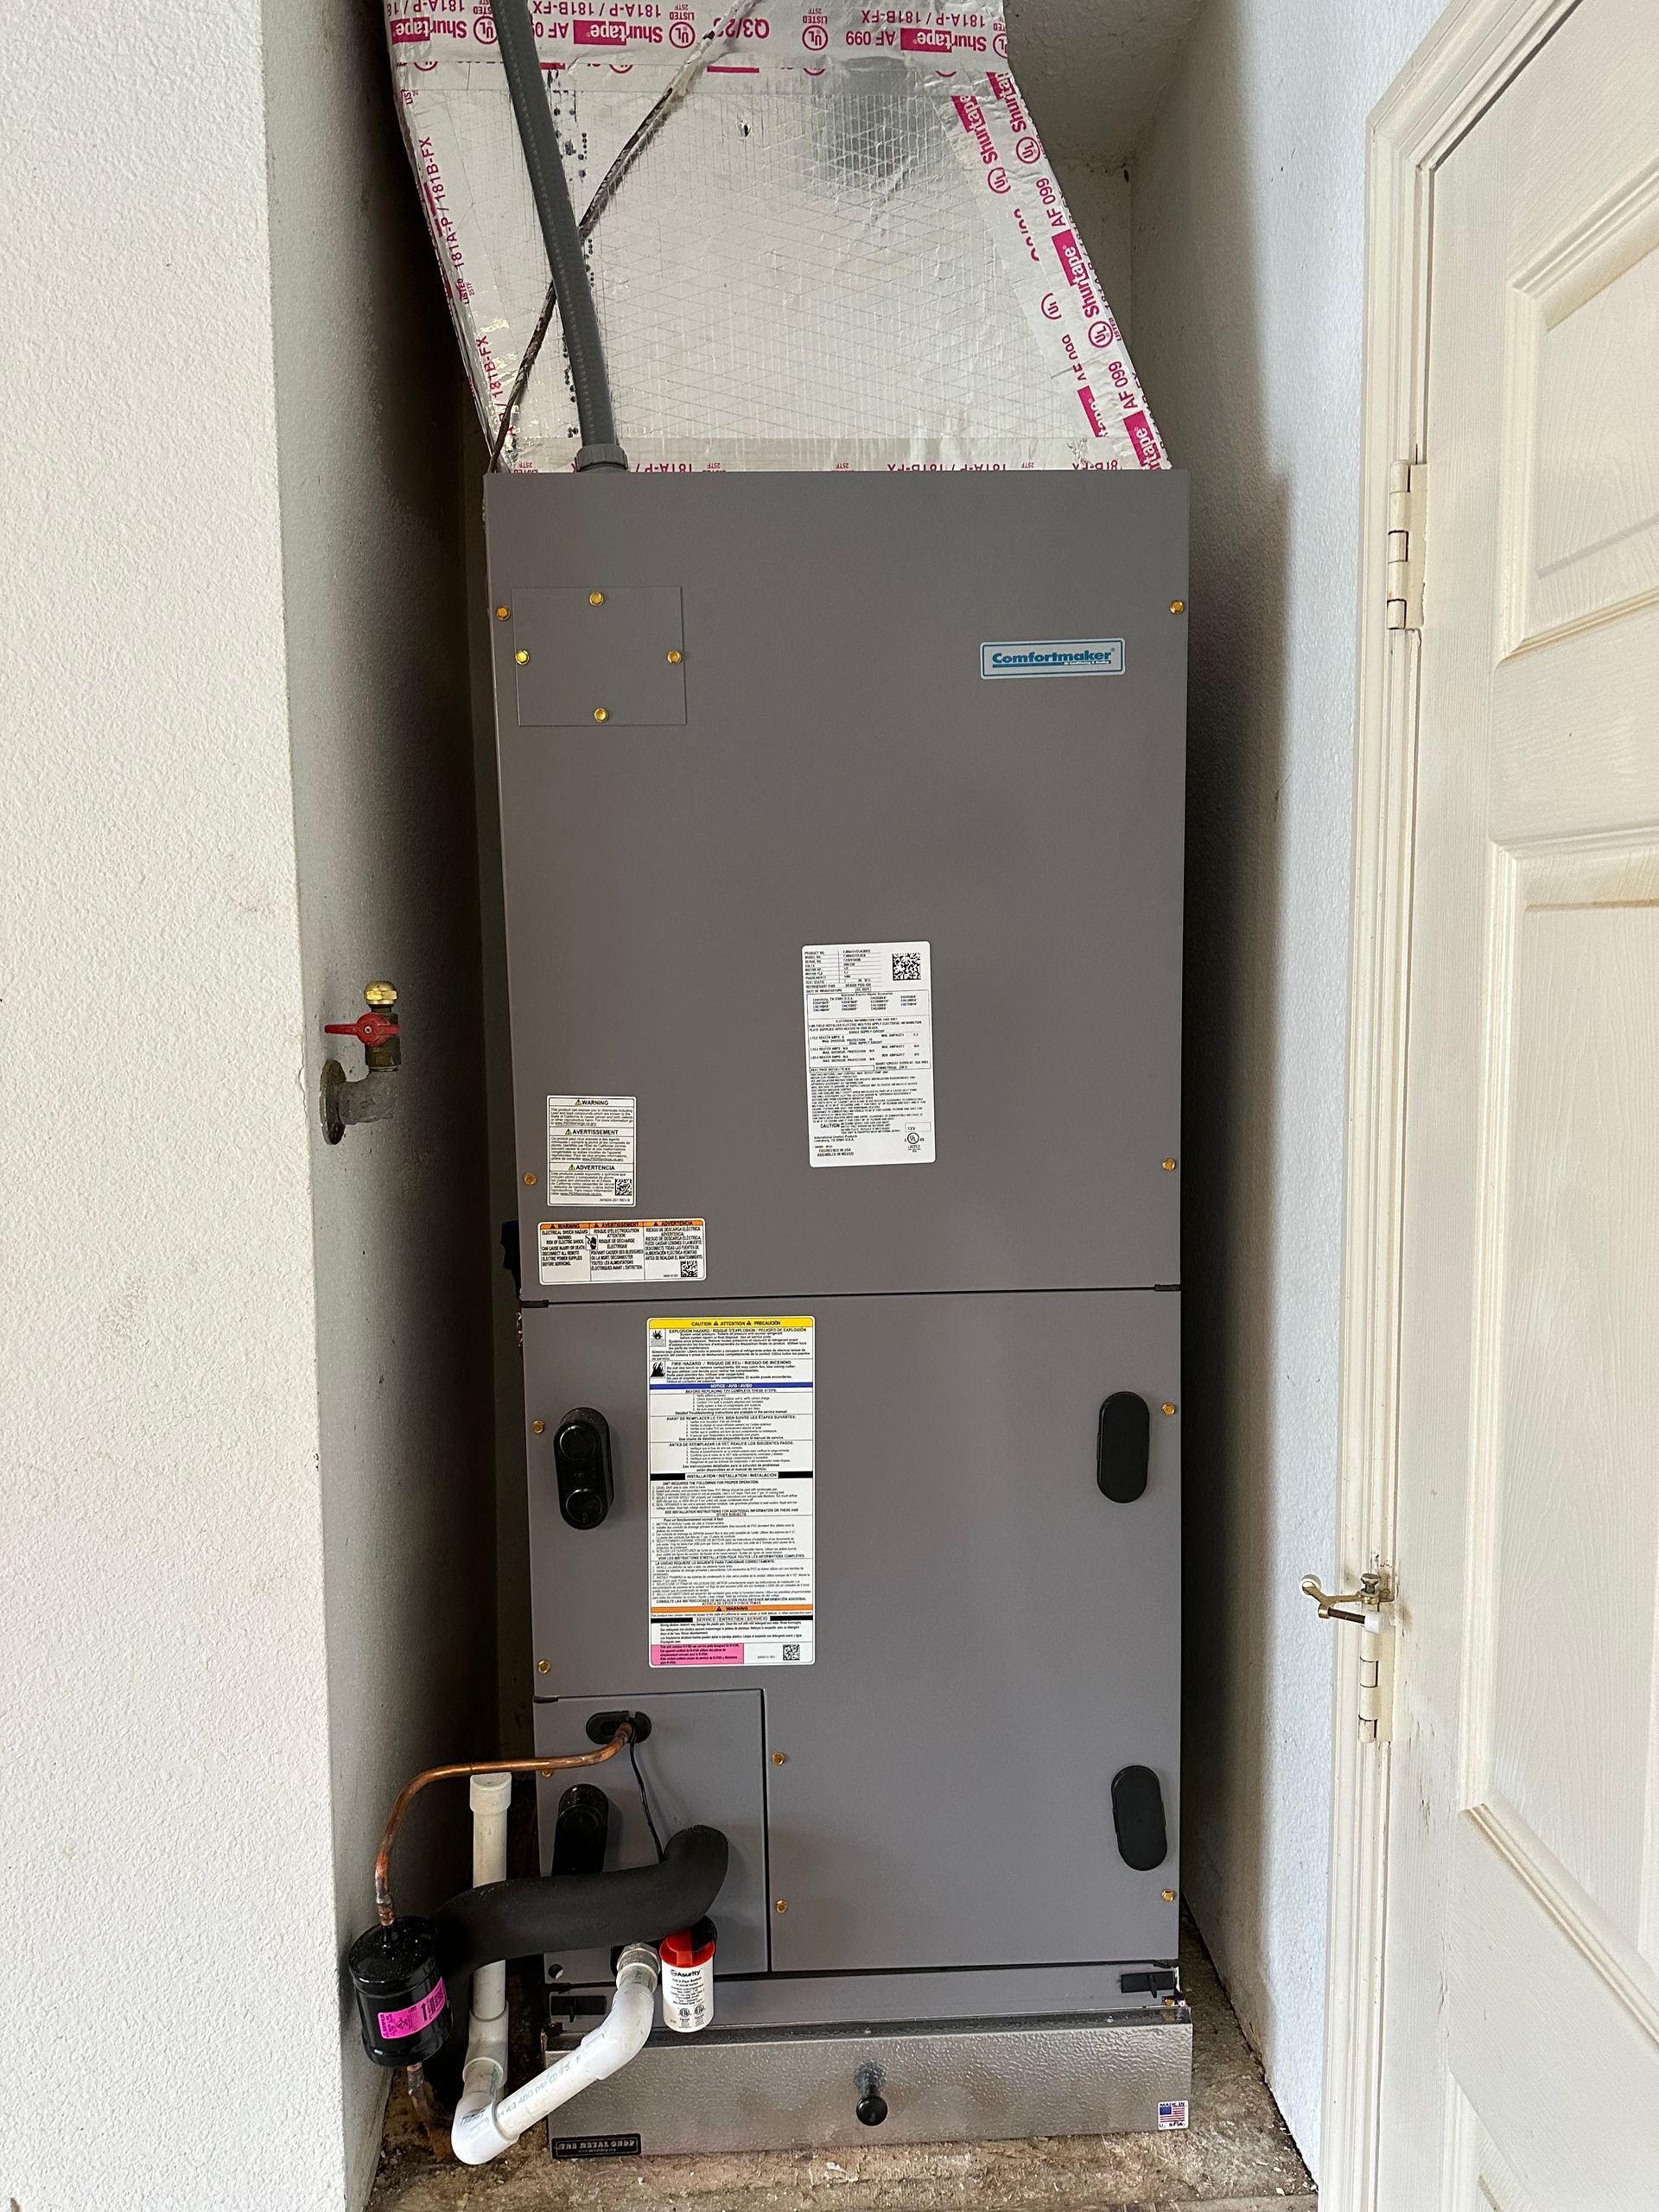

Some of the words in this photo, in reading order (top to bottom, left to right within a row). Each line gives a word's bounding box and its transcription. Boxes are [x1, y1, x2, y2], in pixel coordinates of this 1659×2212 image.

[533, 1, 595, 16] 181B-FX
[609, 3, 661, 17] 181A-P
[670, 11, 695, 21] LISTED
[861, 10, 921, 24] 181B-FX
[803, 16, 828, 24] LISTED
[936, 13, 986, 29] 181A-P
[395, 20, 467, 38] Shurtape
[549, 22, 569, 39] AF
[590, 22, 663, 43] Shurtape
[674, 28, 690, 42] UL
[808, 31, 822, 47] UL
[846, 31, 872, 46] 099
[875, 31, 896, 46] AF
[918, 32, 987, 52] Shurtape
[1021, 141, 1036, 159] UL
[419, 137, 446, 202] 181B-FX
[1036, 177, 1056, 205] 099
[1046, 207, 1066, 227] AF
[1065, 245, 1100, 319] Shurtape
[1094, 325, 1107, 344] UL
[476, 335, 503, 398] 181B-FX
[1108, 360, 1128, 388] 099
[1118, 390, 1139, 410] AF
[992, 650, 1112, 664] Comfortmaker
